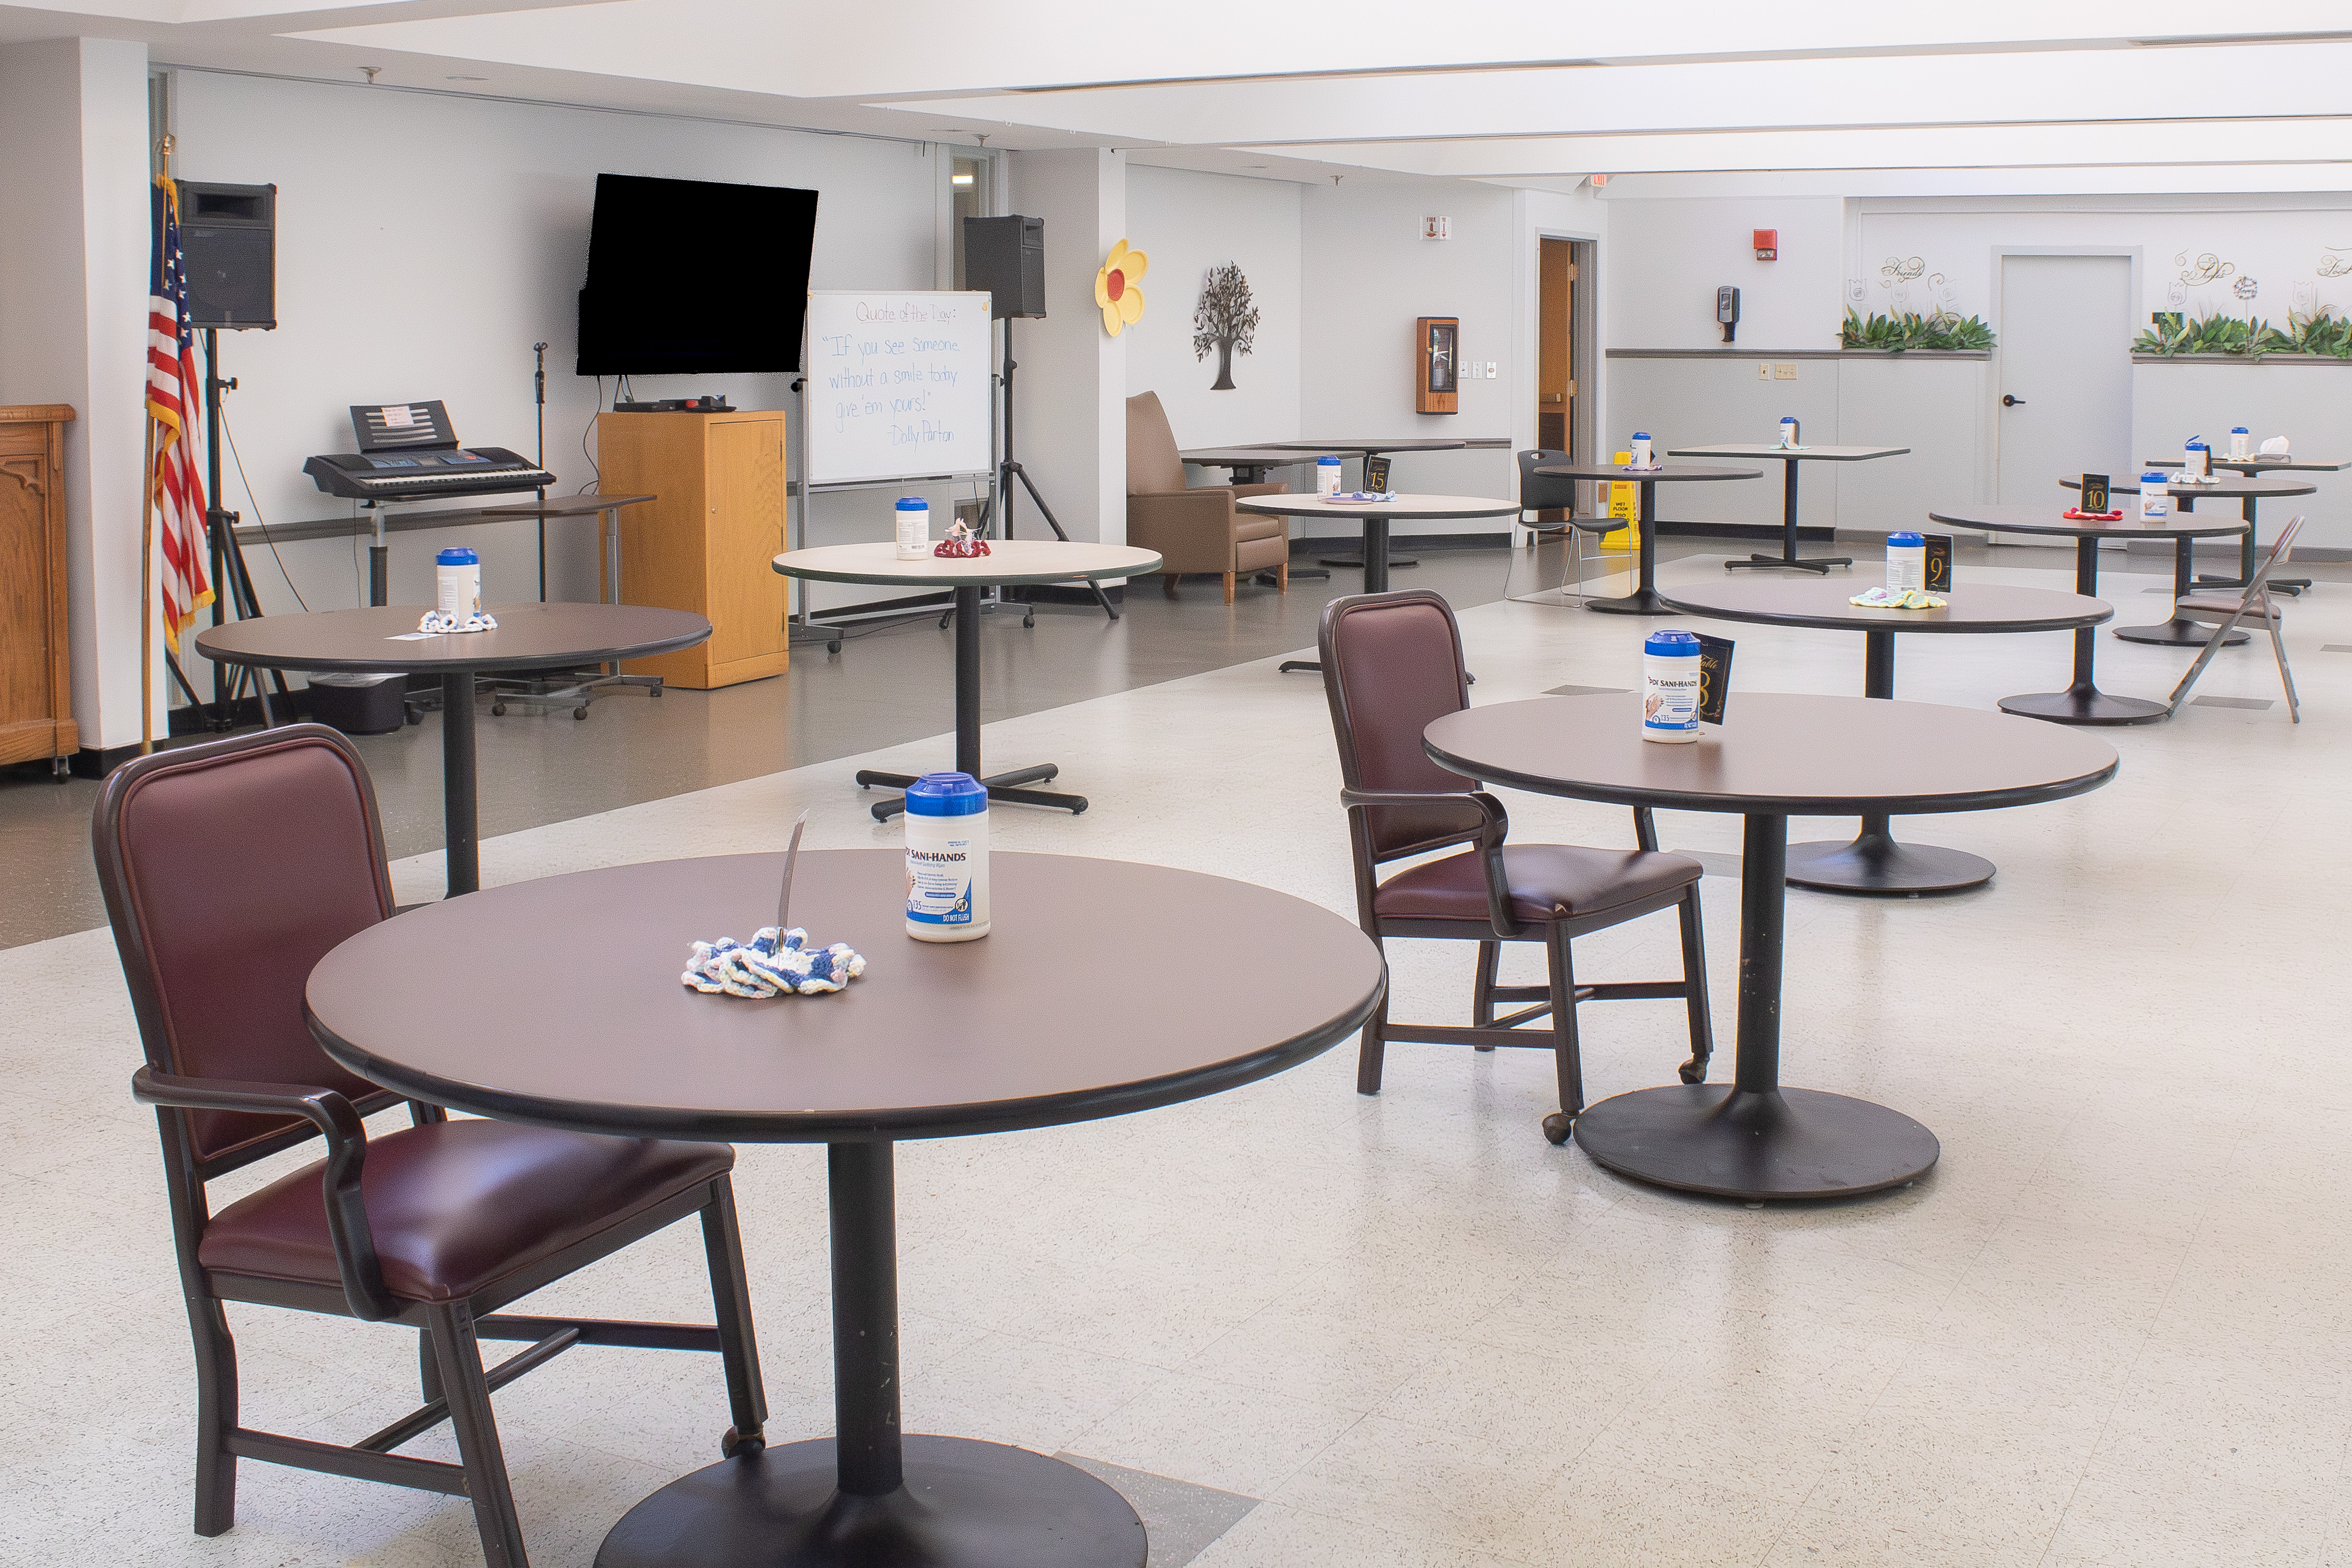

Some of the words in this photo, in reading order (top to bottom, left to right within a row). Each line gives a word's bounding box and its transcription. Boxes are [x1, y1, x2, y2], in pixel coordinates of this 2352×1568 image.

[856, 301, 896, 322] Quote
[899, 302, 910, 319] of
[910, 304, 928, 320] the
[929, 303, 956, 325] Day:
[858, 341, 878, 365] you
[829, 366, 875, 388] without
[880, 372, 888, 385] a
[928, 362, 958, 387] today
[836, 402, 860, 433] give
[922, 420, 955, 443] Parton
[1371, 472, 1384, 488] 15
[2087, 490, 2105, 510] 10
[1931, 558, 1943, 582] 9
[911, 849, 967, 862] SANI-HANDS
[913, 899, 922, 910] 135
